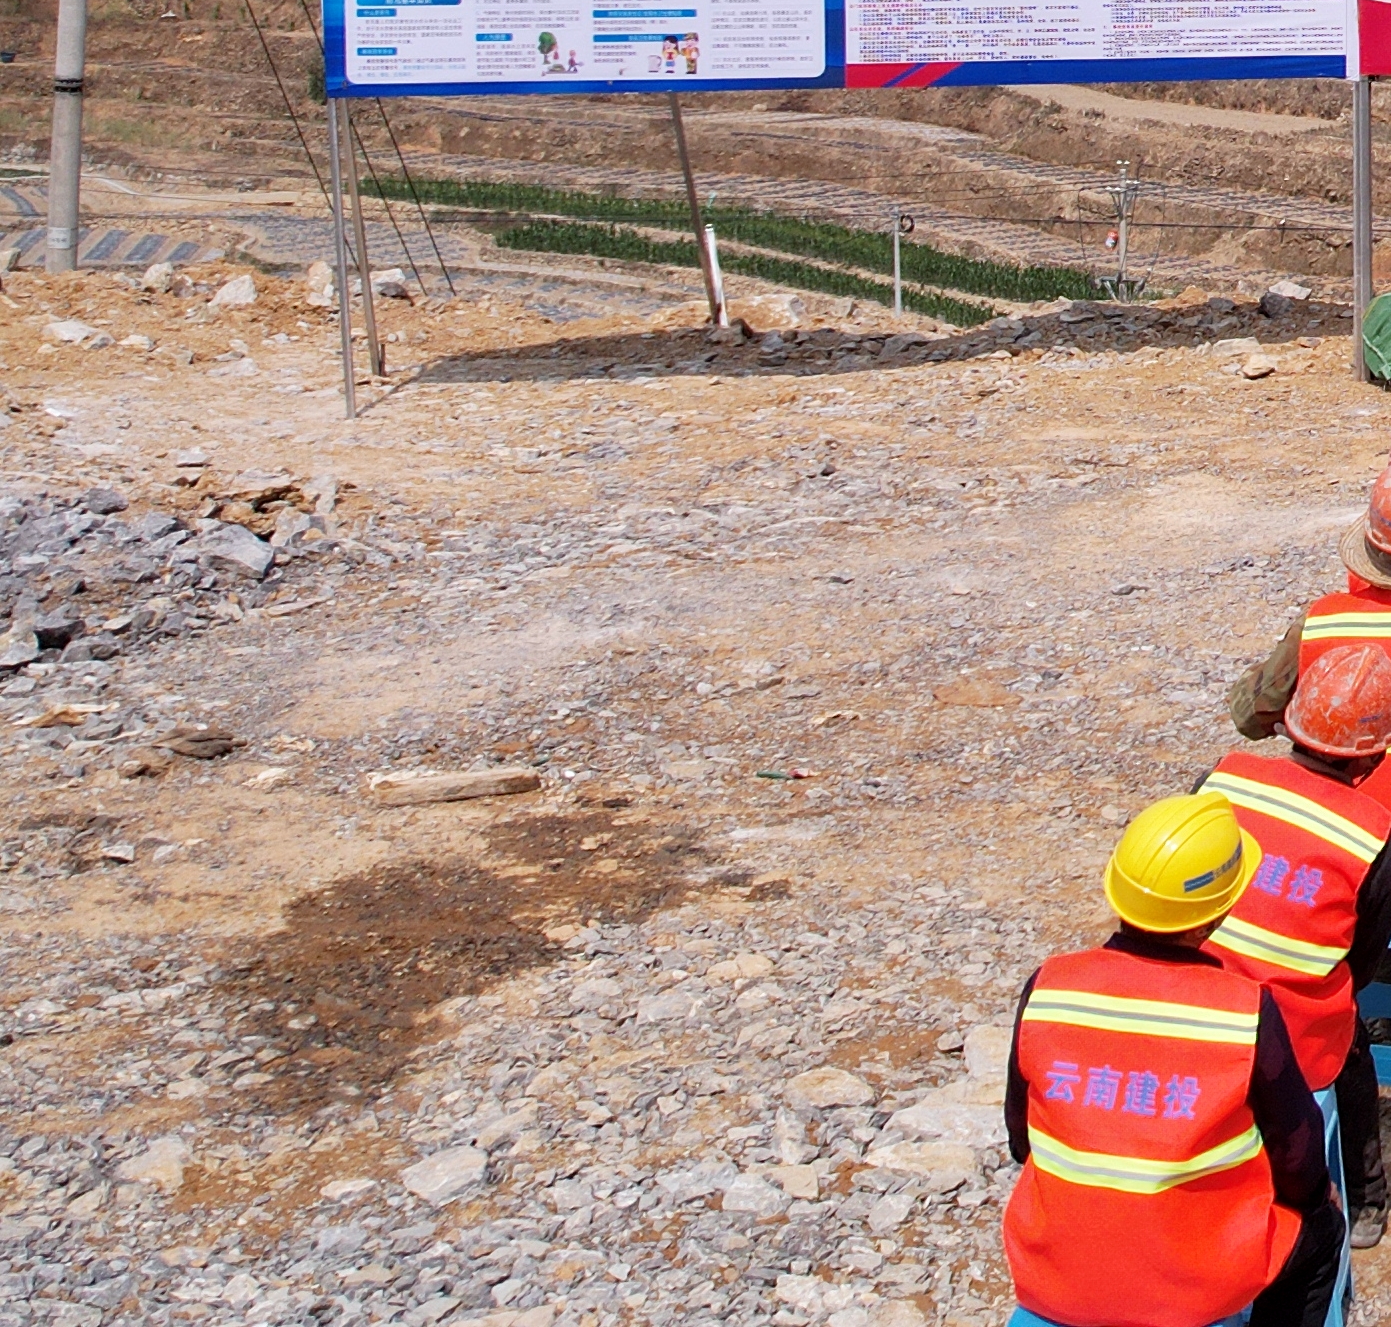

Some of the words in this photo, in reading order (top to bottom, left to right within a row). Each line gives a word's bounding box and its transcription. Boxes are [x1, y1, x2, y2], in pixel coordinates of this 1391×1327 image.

[1256, 854, 1322, 907] 建投
[1044, 1060, 1201, 1120] 云南建投
